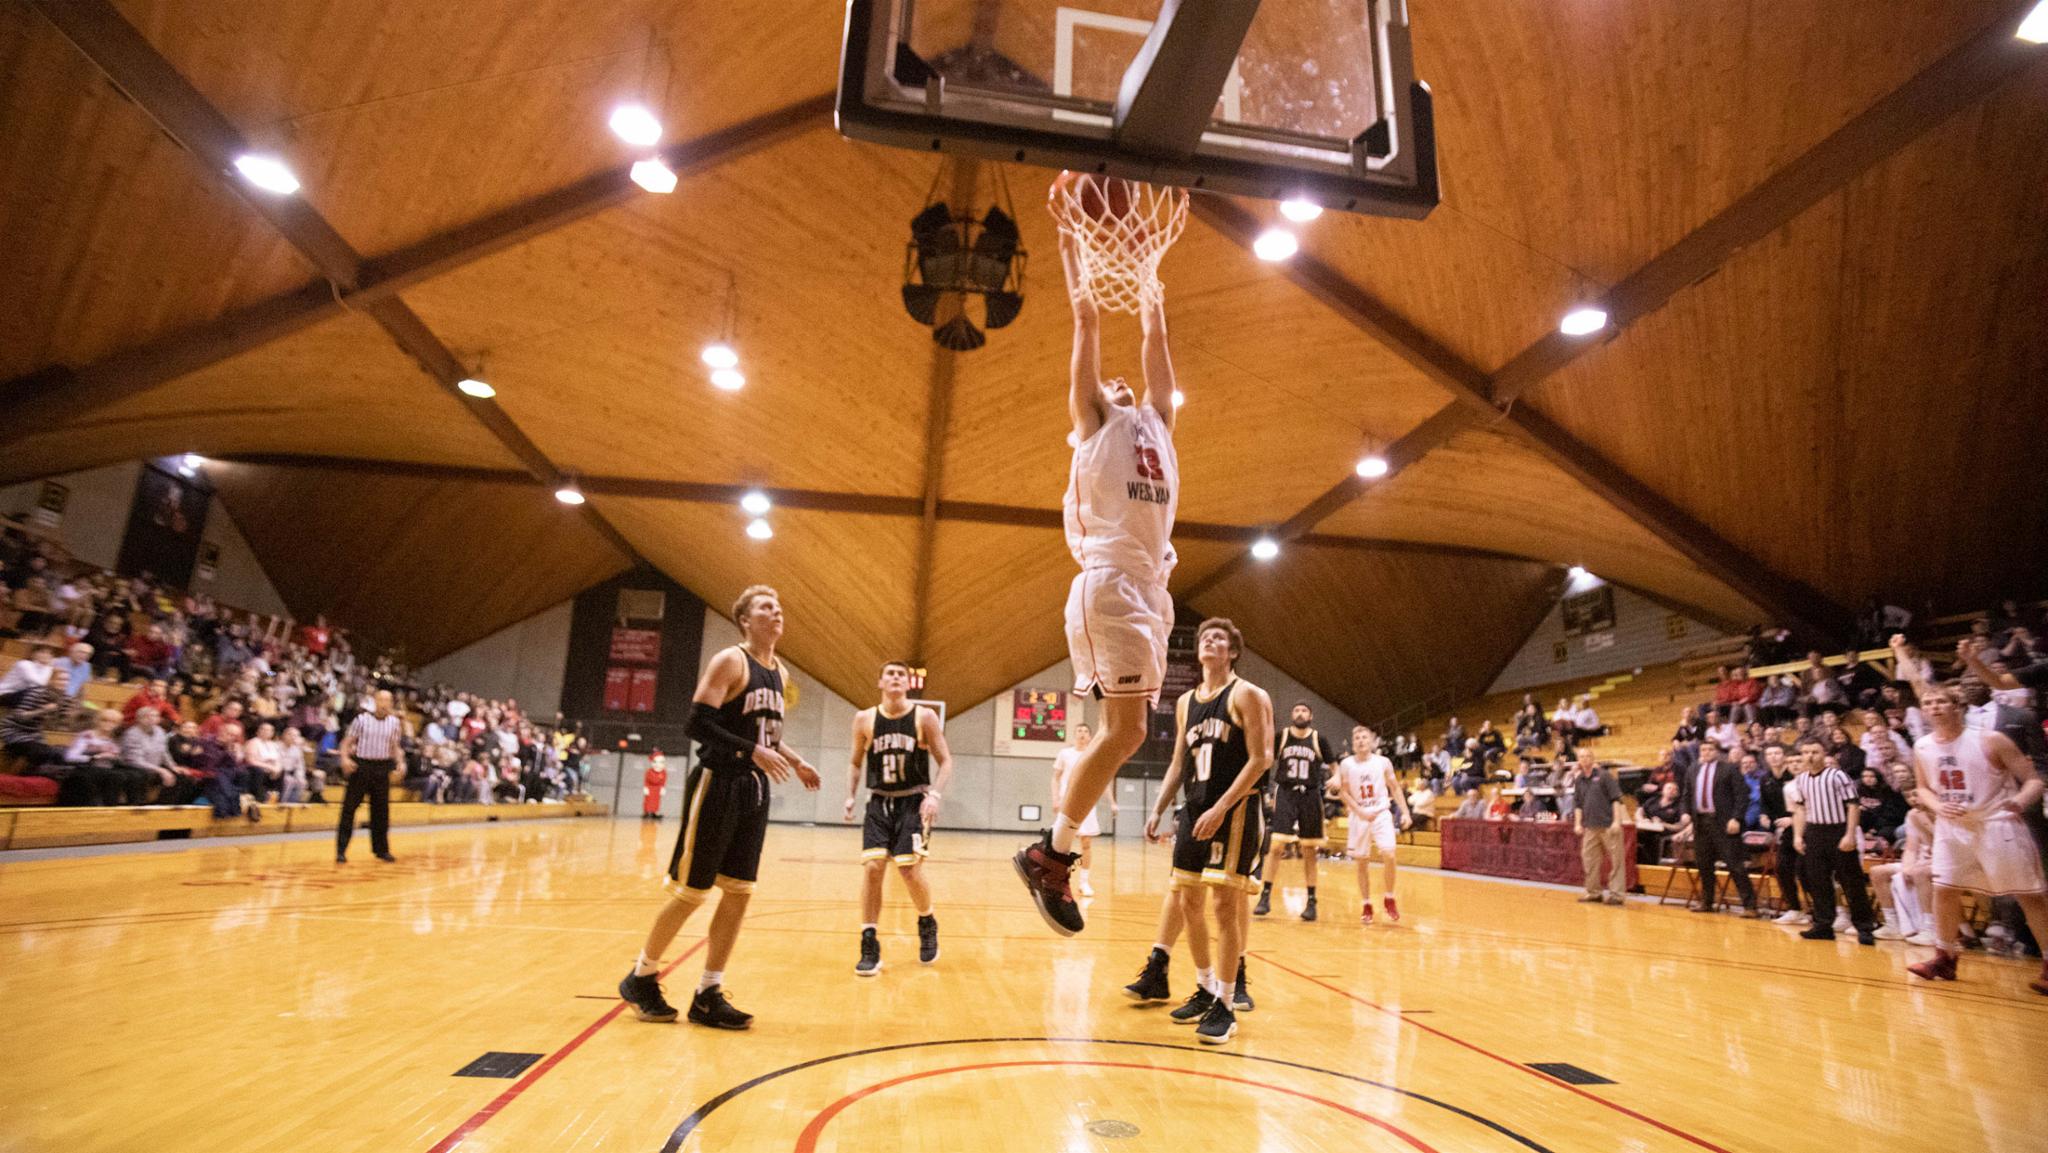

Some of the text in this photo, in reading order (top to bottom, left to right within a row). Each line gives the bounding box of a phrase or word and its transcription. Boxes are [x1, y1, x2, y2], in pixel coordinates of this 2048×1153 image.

[873, 732, 916, 754] DEPAUW
[882, 754, 907, 784] 21
[1287, 758, 1310, 780] 30
[1939, 770, 1966, 790] 42
